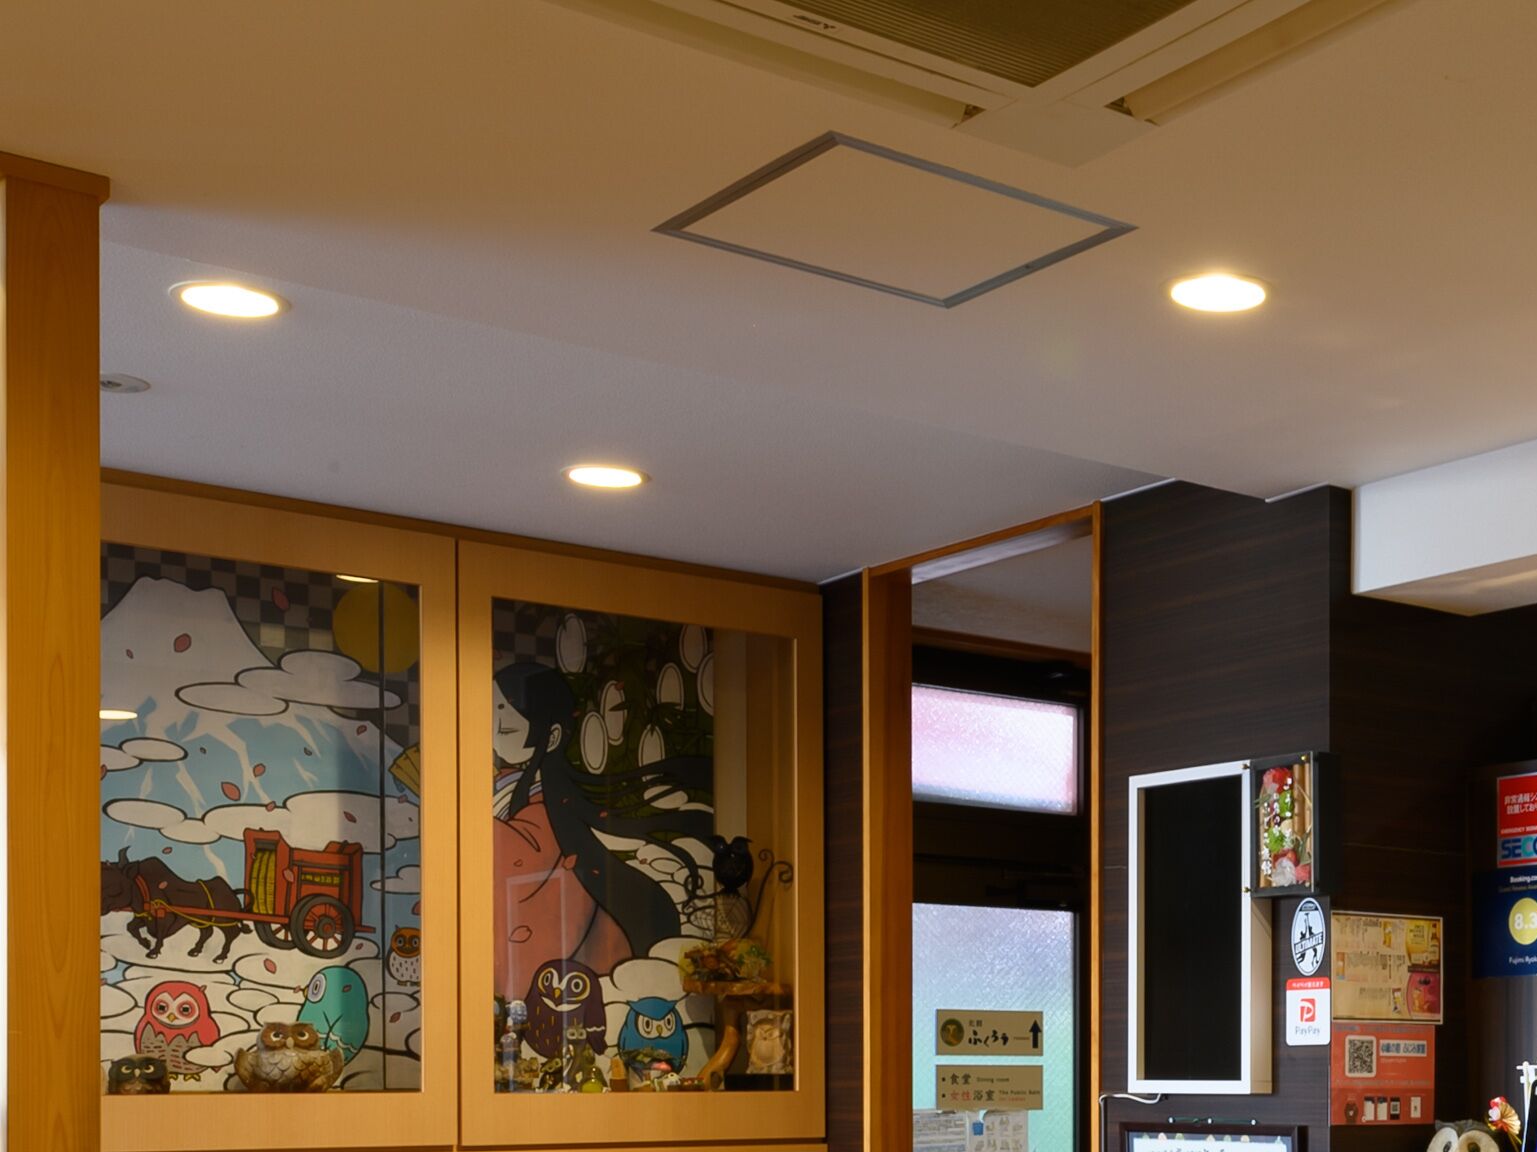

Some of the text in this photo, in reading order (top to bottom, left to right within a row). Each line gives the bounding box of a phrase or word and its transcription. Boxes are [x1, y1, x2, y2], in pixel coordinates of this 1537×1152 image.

[1295, 1025, 1320, 1036] PayPay
[968, 1029, 1009, 1048] ふくろう
[950, 1072, 972, 1086] 食堂
